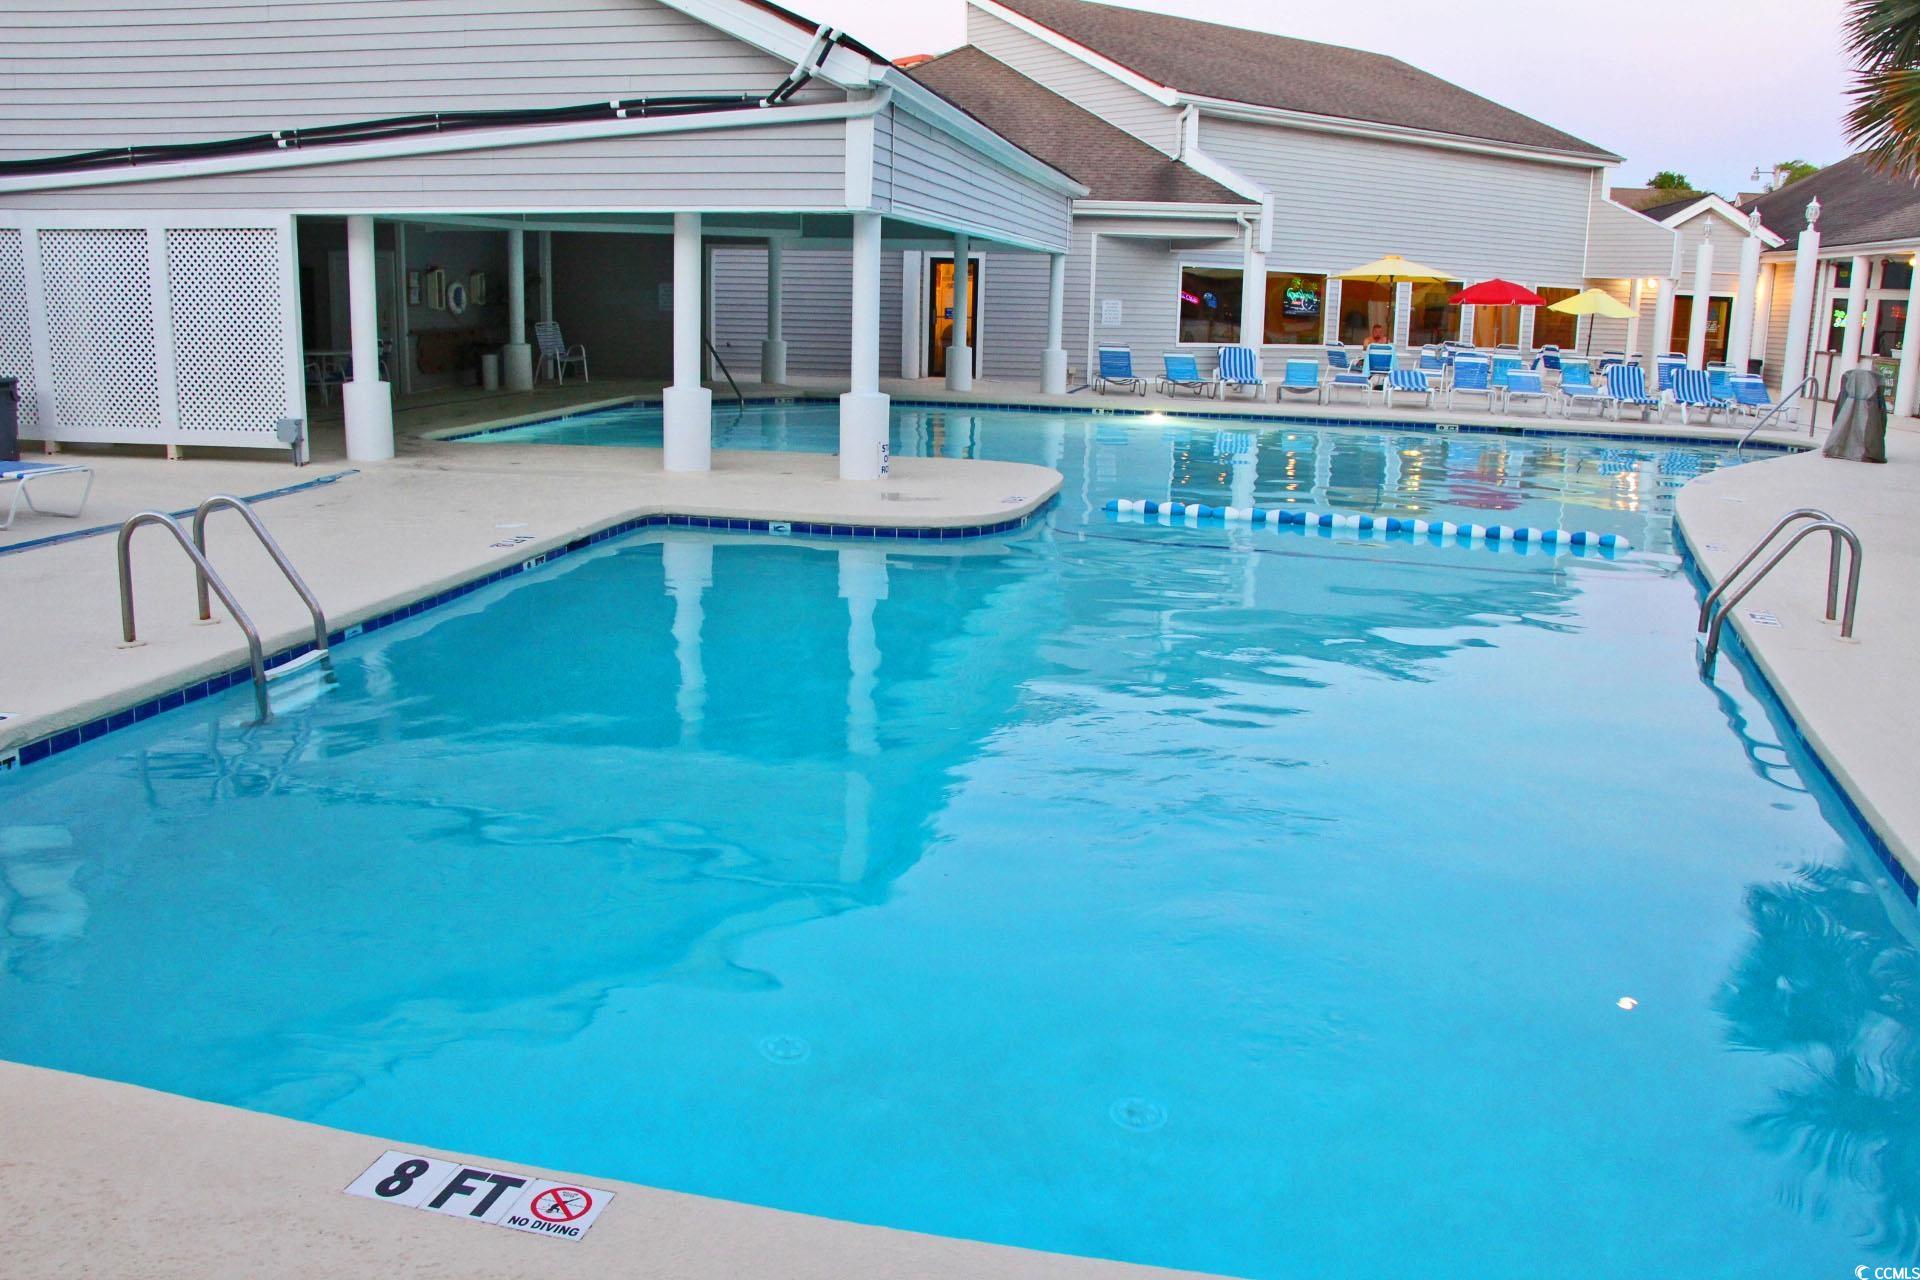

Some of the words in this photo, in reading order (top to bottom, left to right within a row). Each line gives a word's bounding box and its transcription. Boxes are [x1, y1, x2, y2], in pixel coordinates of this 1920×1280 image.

[374, 1159, 430, 1198] 8
[427, 1168, 527, 1217] FT
[507, 1215, 529, 1226] NO
[530, 1220, 580, 1237] DIVING
